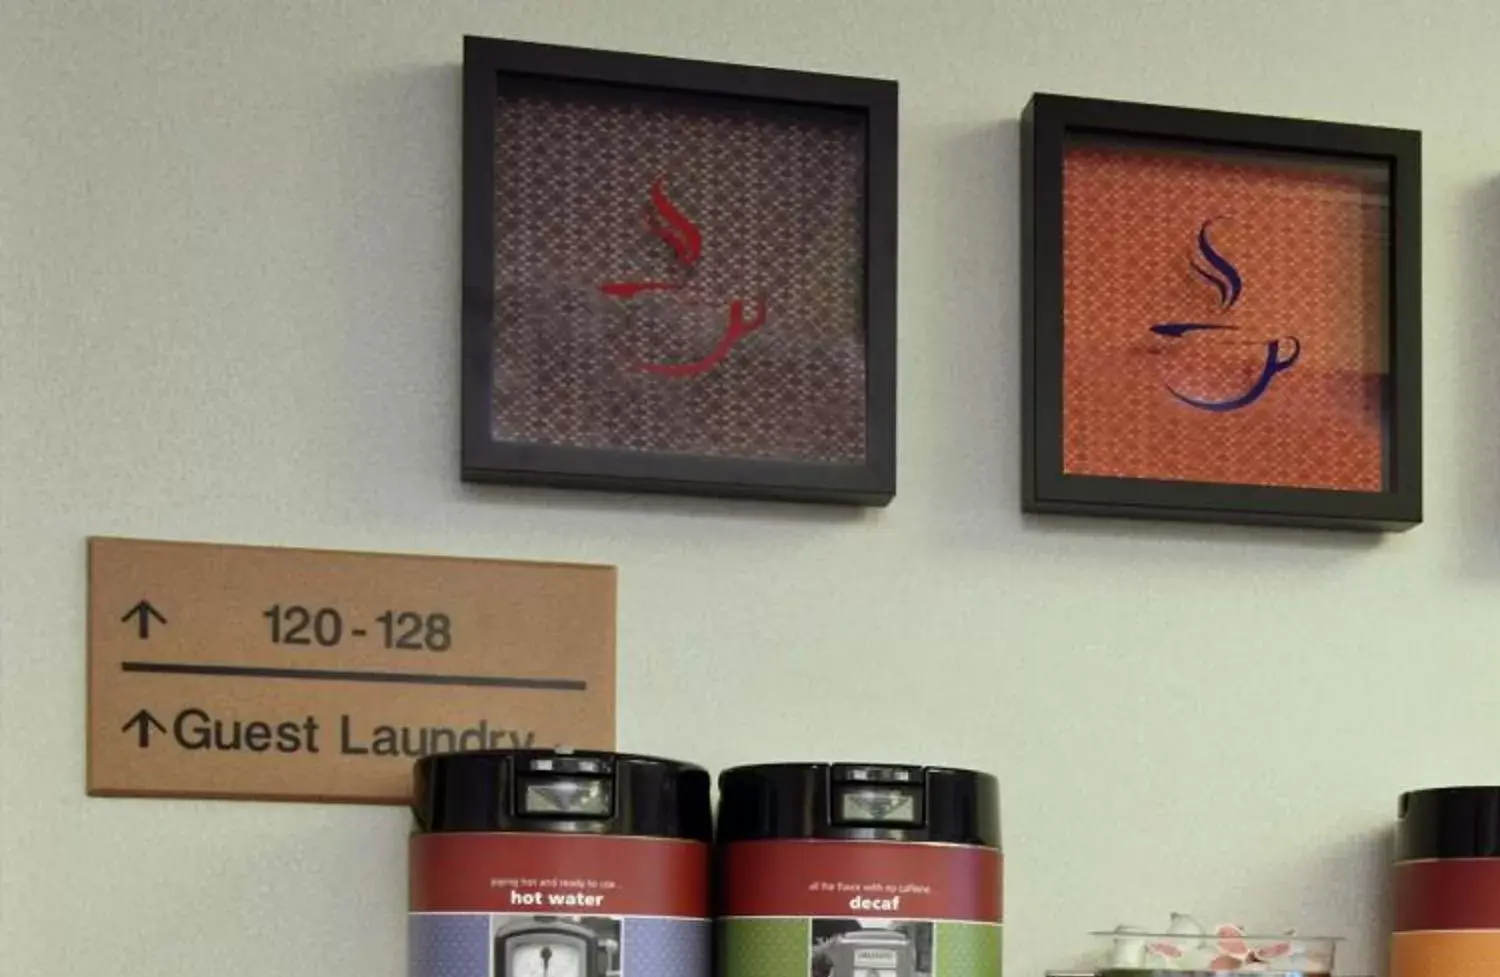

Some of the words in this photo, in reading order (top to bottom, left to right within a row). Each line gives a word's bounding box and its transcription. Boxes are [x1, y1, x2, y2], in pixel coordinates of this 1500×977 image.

[172, 708, 320, 754] Guest
[510, 889, 543, 905] hot
[548, 892, 604, 907] water
[848, 895, 900, 911] decaf
